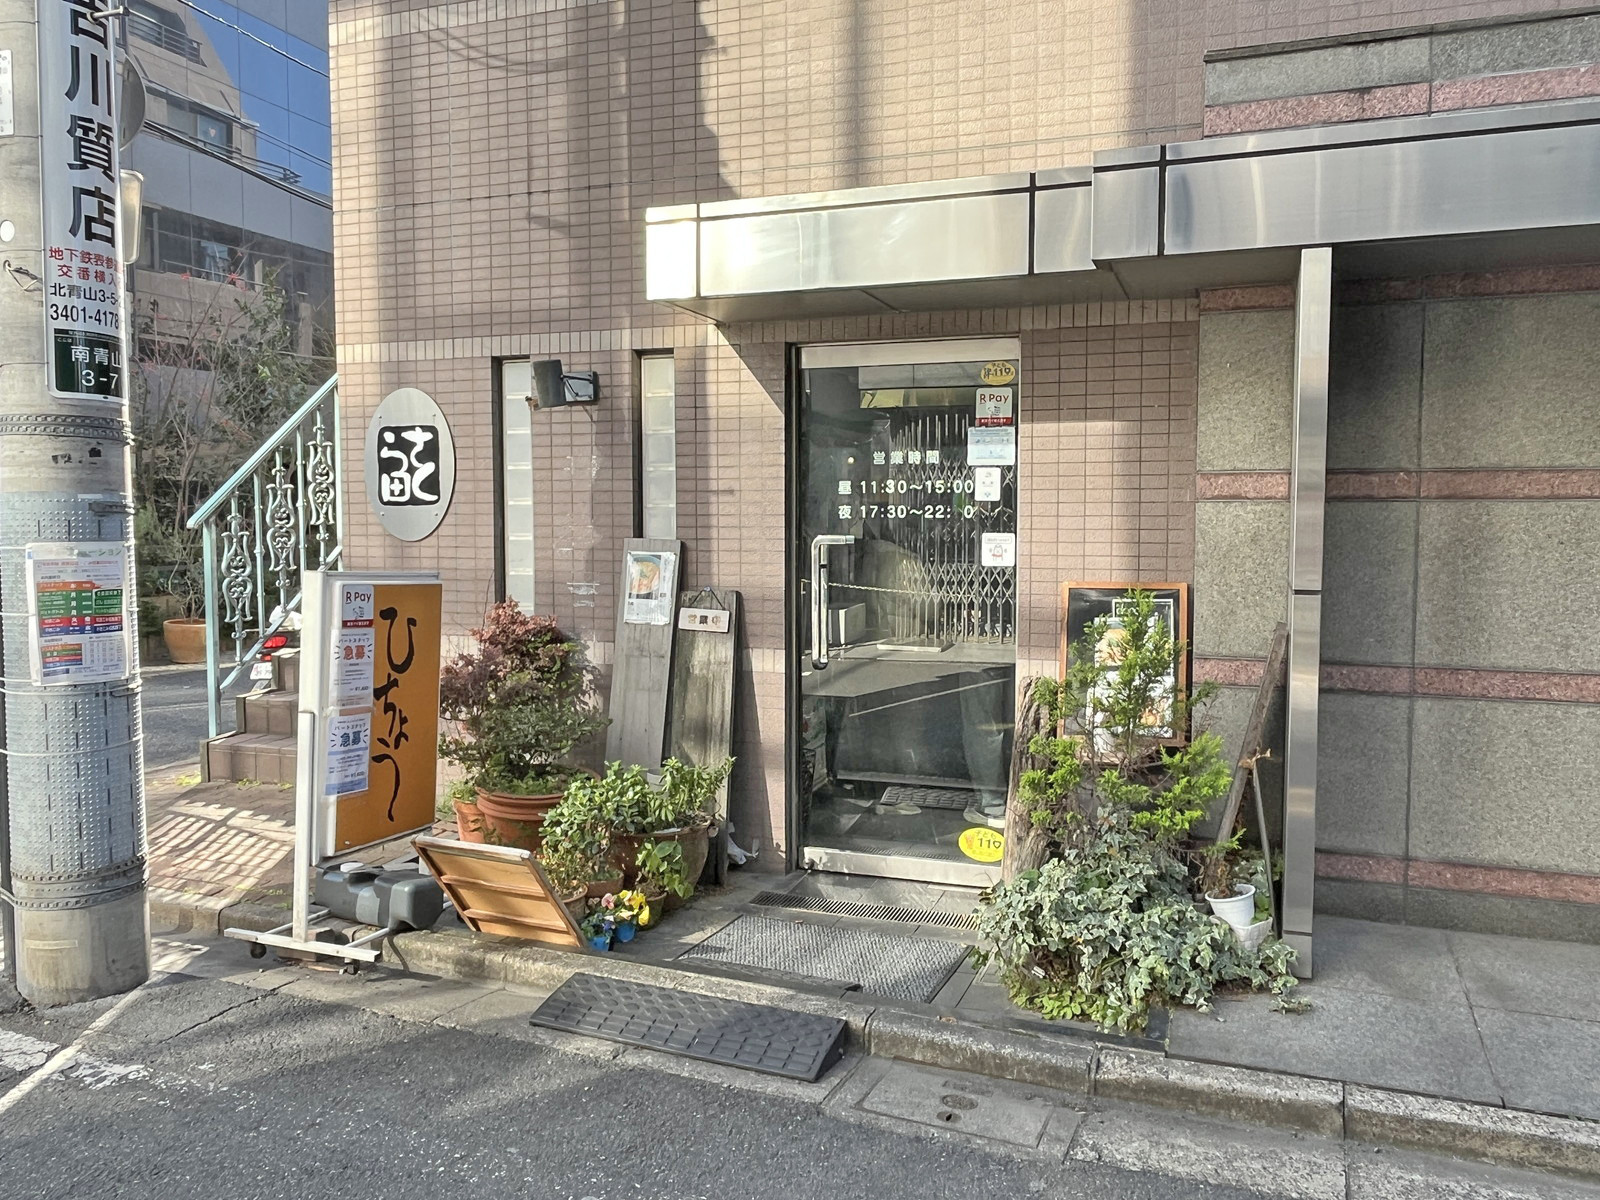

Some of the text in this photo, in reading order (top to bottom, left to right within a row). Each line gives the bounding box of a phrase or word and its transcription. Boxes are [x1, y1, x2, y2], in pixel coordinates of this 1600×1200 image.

[50, 303, 119, 329] 3401-4178
[71, 345, 121, 368] 南青山
[81, 369, 118, 389] 3-7
[989, 393, 1010, 404] Pay
[873, 450, 940, 465] 営業時間
[838, 480, 852, 495] 昼
[838, 505, 852, 519] 夜
[354, 591, 372, 603] Pay
[371, 607, 417, 822] ひちょう
